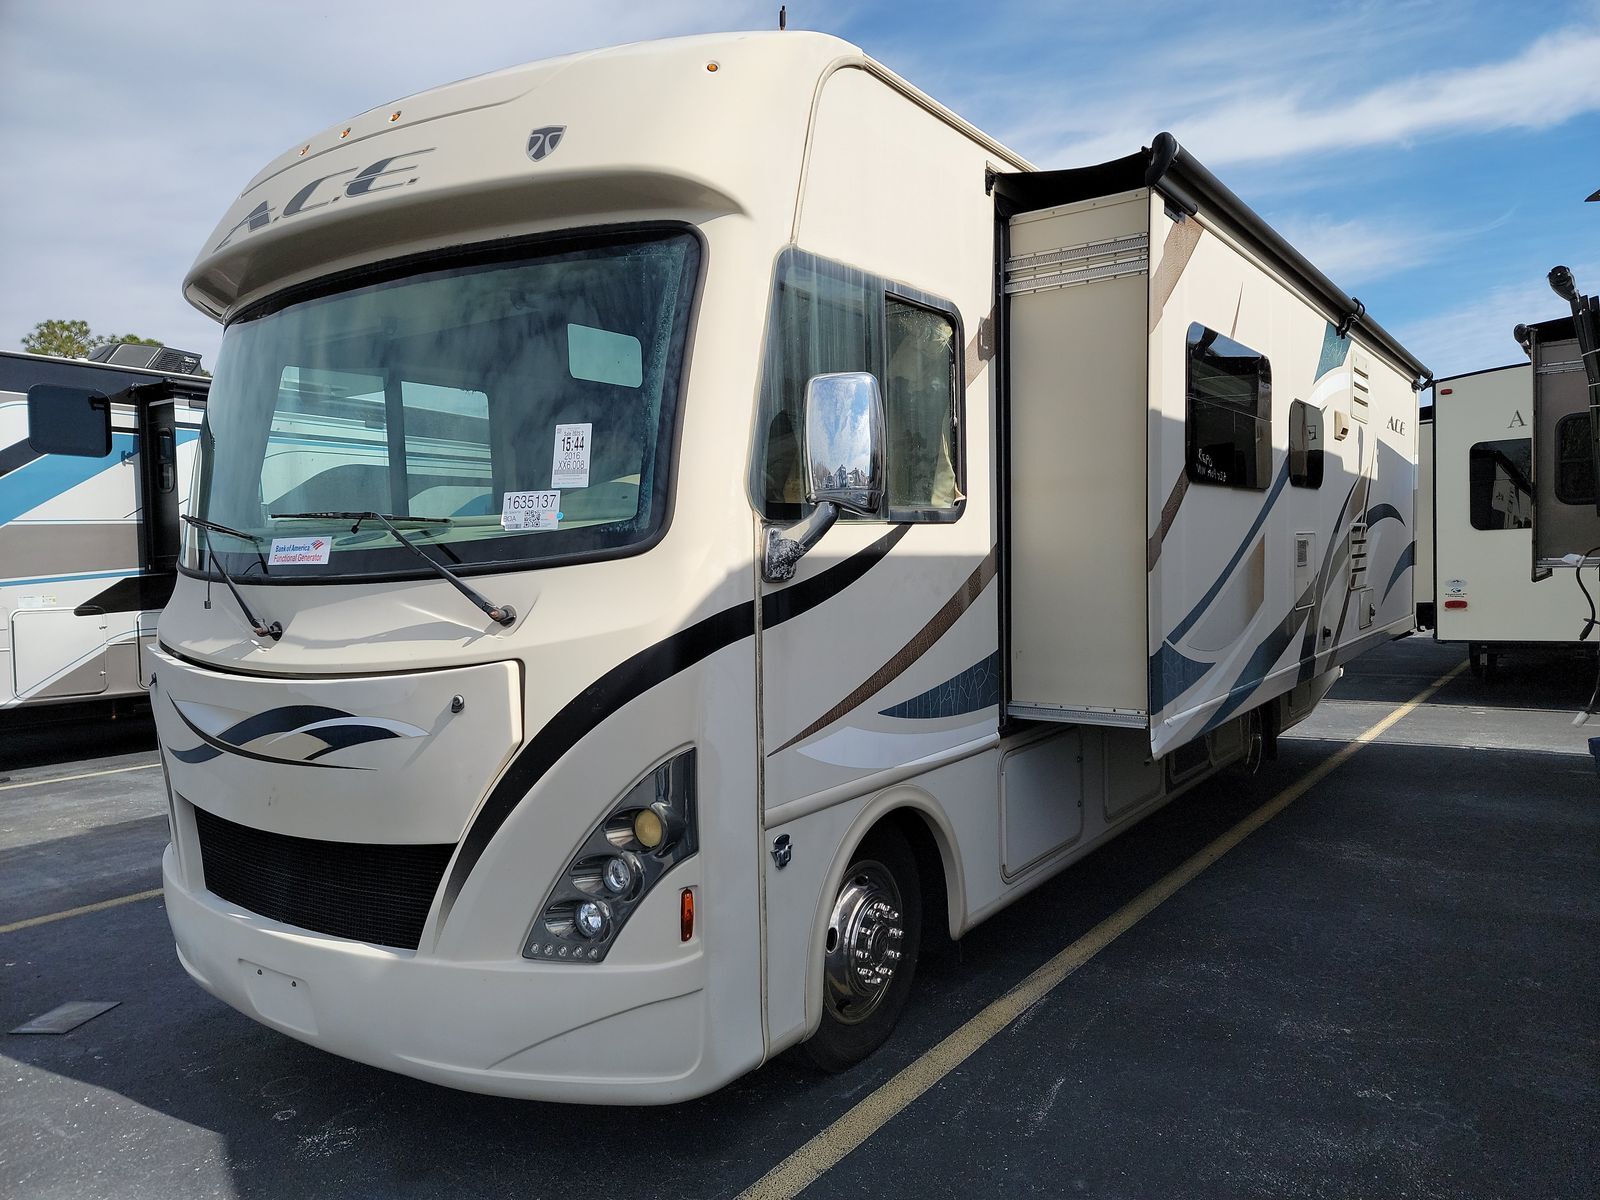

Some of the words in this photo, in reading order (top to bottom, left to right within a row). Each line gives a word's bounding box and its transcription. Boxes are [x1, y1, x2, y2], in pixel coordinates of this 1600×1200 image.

[1386, 415, 1406, 437] ACE
[561, 436, 585, 452] 15:44
[564, 452, 581, 460] 2016
[507, 494, 557, 510] 1635137
[275, 545, 287, 553] Bank
[291, 544, 311, 552] America
[273, 554, 297, 562] Functional
[297, 553, 323, 562] Generator
